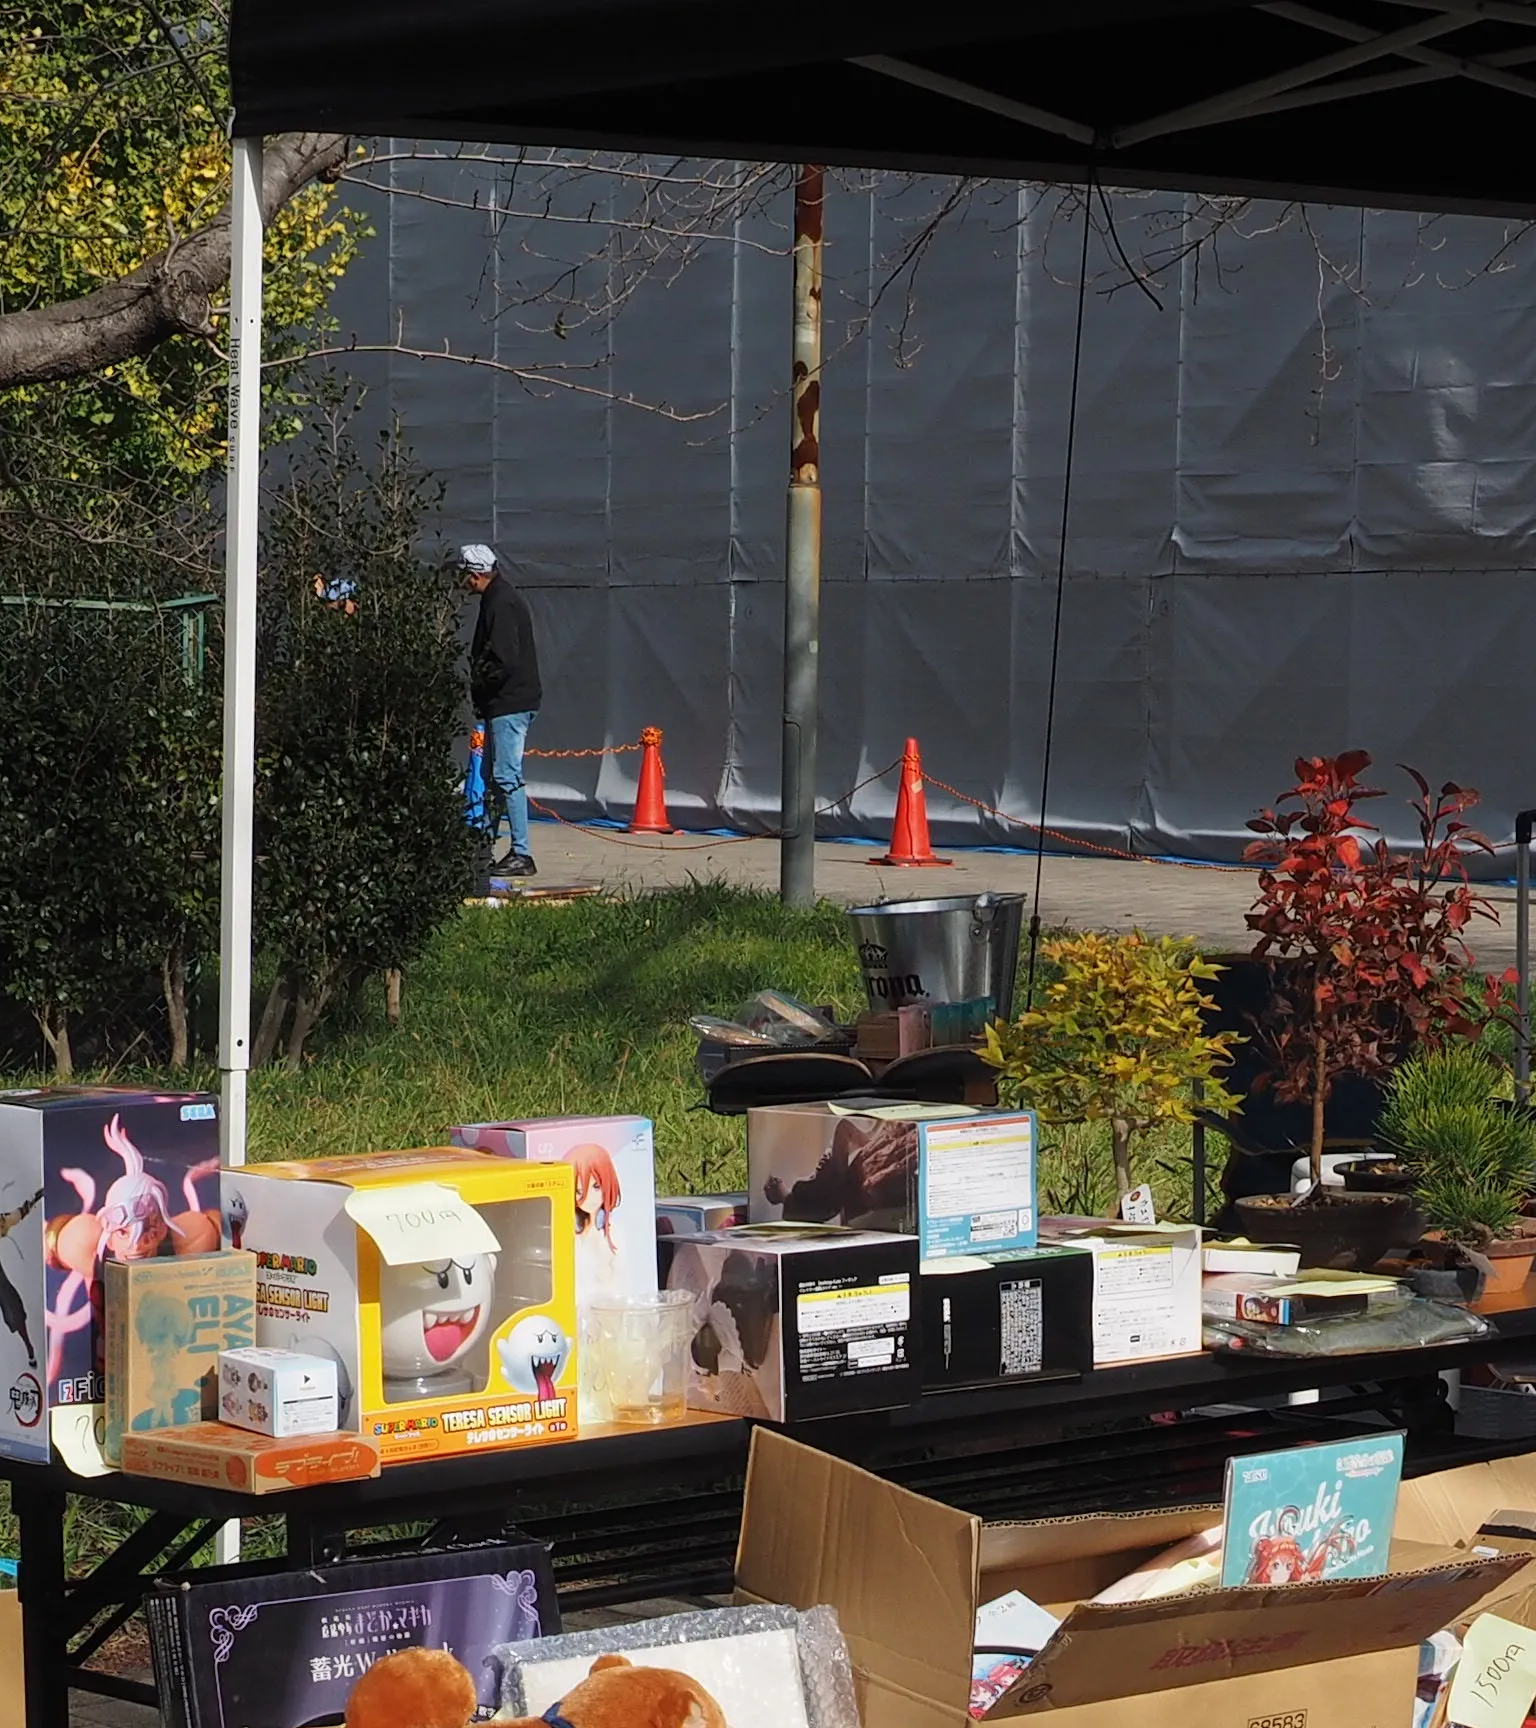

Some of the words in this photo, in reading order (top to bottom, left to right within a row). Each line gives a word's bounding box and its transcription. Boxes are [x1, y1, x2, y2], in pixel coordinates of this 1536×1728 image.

[180, 1103, 217, 1122] SEGA
[385, 1206, 464, 1234] 700円
[281, 1253, 318, 1276] MARIO
[268, 1284, 302, 1309] SENSOR
[303, 1288, 329, 1313] LIGHT
[187, 1294, 220, 1355] ELI
[222, 1293, 254, 1350] AYA
[374, 1421, 407, 1435] SUPER
[406, 1416, 439, 1431] MARIO
[440, 1407, 486, 1433] TERESA
[487, 1402, 532, 1426] SENSOR
[534, 1398, 567, 1420] LIGHT
[309, 1656, 354, 1683] 蓄光
[1470, 1644, 1525, 1709] 1500円
[477, 1705, 497, 1718] 数字
